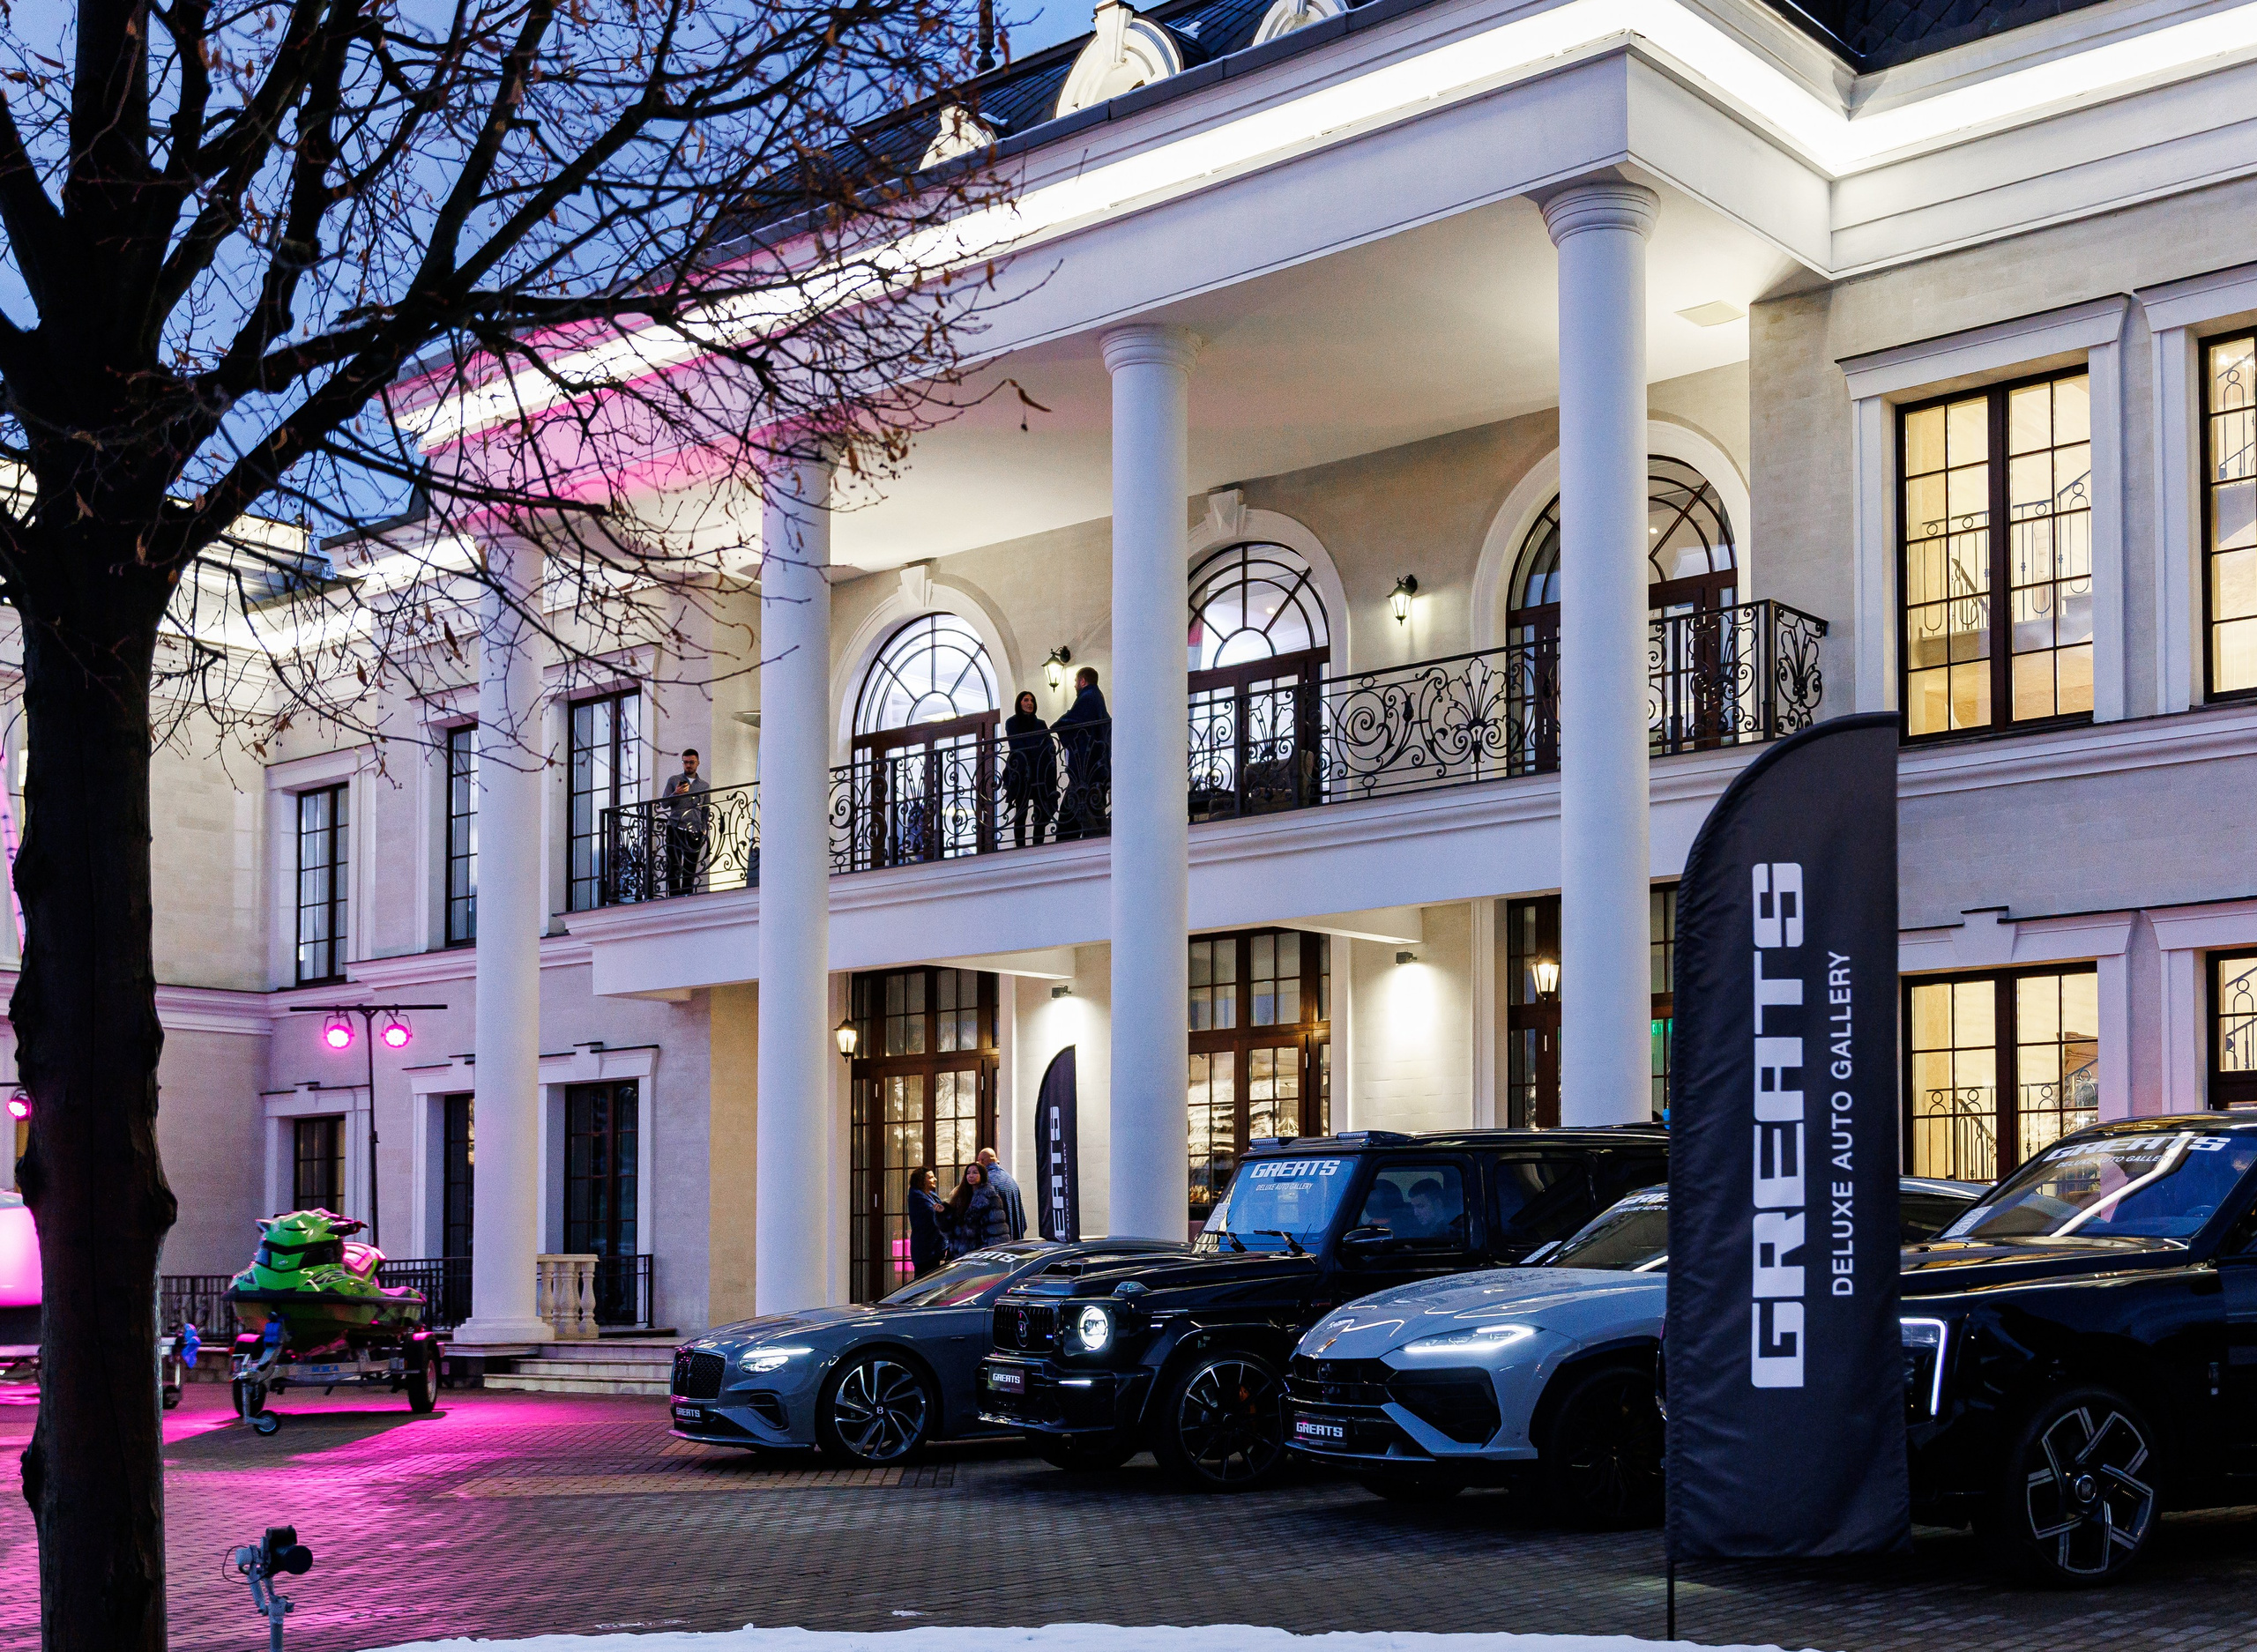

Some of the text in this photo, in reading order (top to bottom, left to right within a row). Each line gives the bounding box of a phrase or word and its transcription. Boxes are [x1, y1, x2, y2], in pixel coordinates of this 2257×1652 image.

[1751, 862, 1805, 1388] GREATS
[1828, 951, 1853, 1296] DELUXE AUTO GALLERY
[2042, 1136, 2231, 1162] GREATS
[1049, 1105, 1067, 1241] EATS
[1250, 1160, 1341, 1179] GREATS
[1613, 1192, 1669, 1207] GRE
[992, 1373, 1020, 1384] GREATS
[675, 1407, 700, 1418] GREATS
[876, 1406, 883, 1415] B
[1296, 1421, 1343, 1438] GREATS
